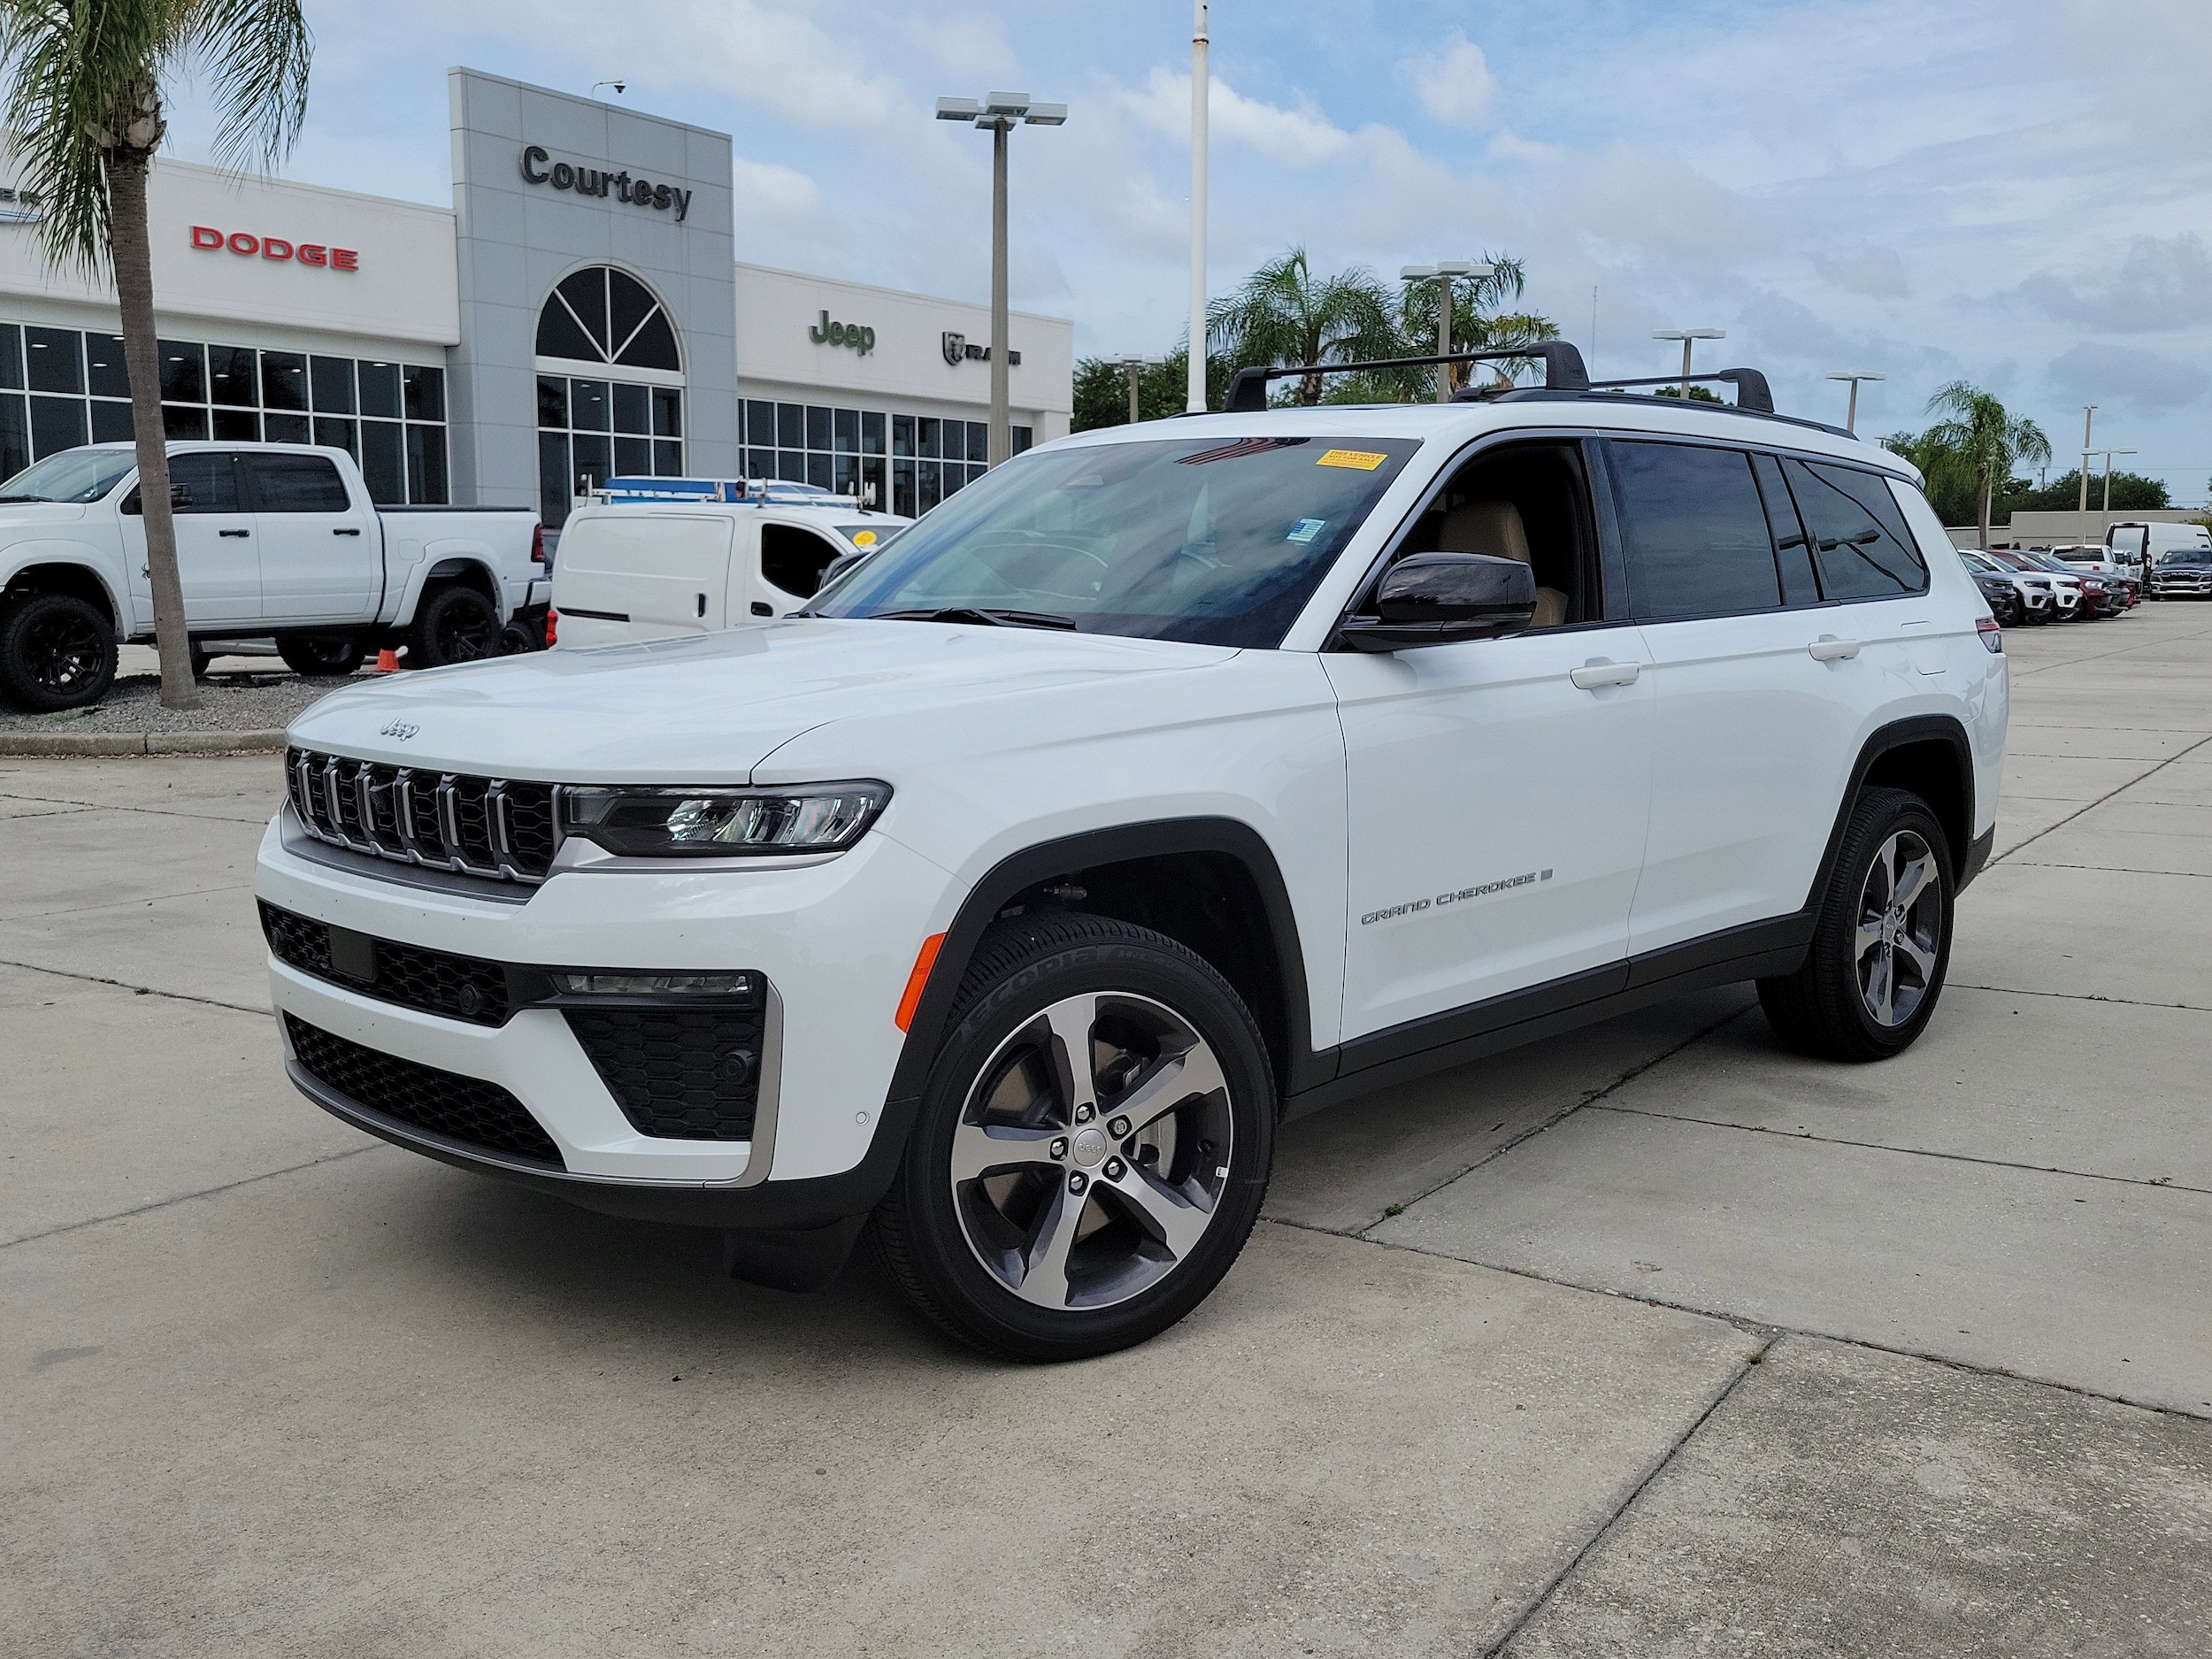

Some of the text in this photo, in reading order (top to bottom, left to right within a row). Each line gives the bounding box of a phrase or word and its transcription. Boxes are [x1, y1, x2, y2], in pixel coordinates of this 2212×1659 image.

[519, 145, 693, 222] Courtesy
[189, 225, 359, 271] DODGE
[809, 310, 875, 357] Jeep
[380, 718, 419, 741] Jeep
[1361, 898, 1431, 926] GRAND
[1436, 872, 1537, 906] CHEROKEE
